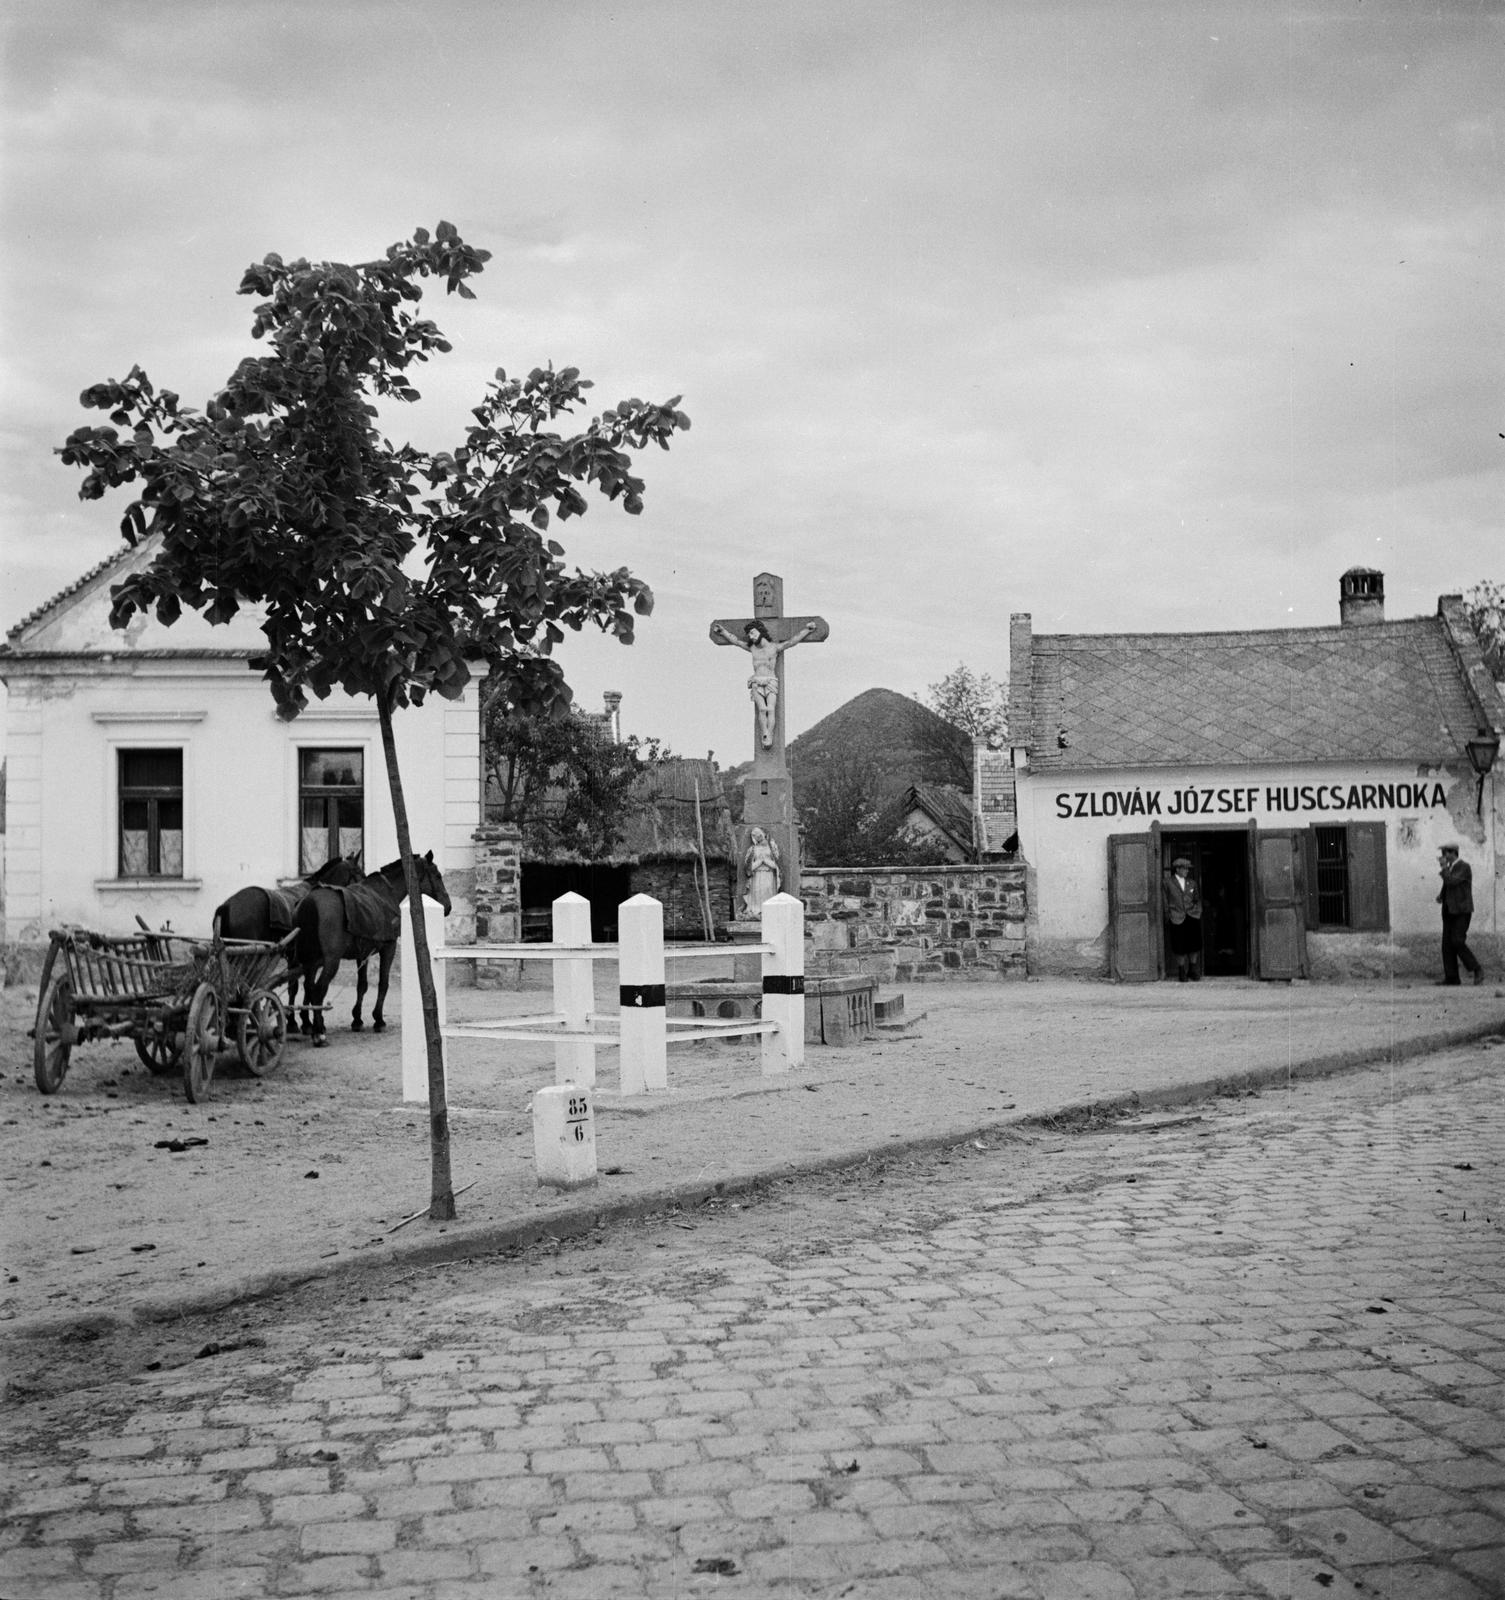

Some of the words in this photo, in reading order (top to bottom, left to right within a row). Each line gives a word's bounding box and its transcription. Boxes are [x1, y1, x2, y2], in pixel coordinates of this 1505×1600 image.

[1056, 787, 1161, 818] SZLOVÁK
[1167, 786, 1260, 815] JÓZSEF
[1266, 783, 1446, 812] HUSCSARNOKA
[569, 1097, 587, 1115] 85
[575, 1125, 584, 1142] 6
